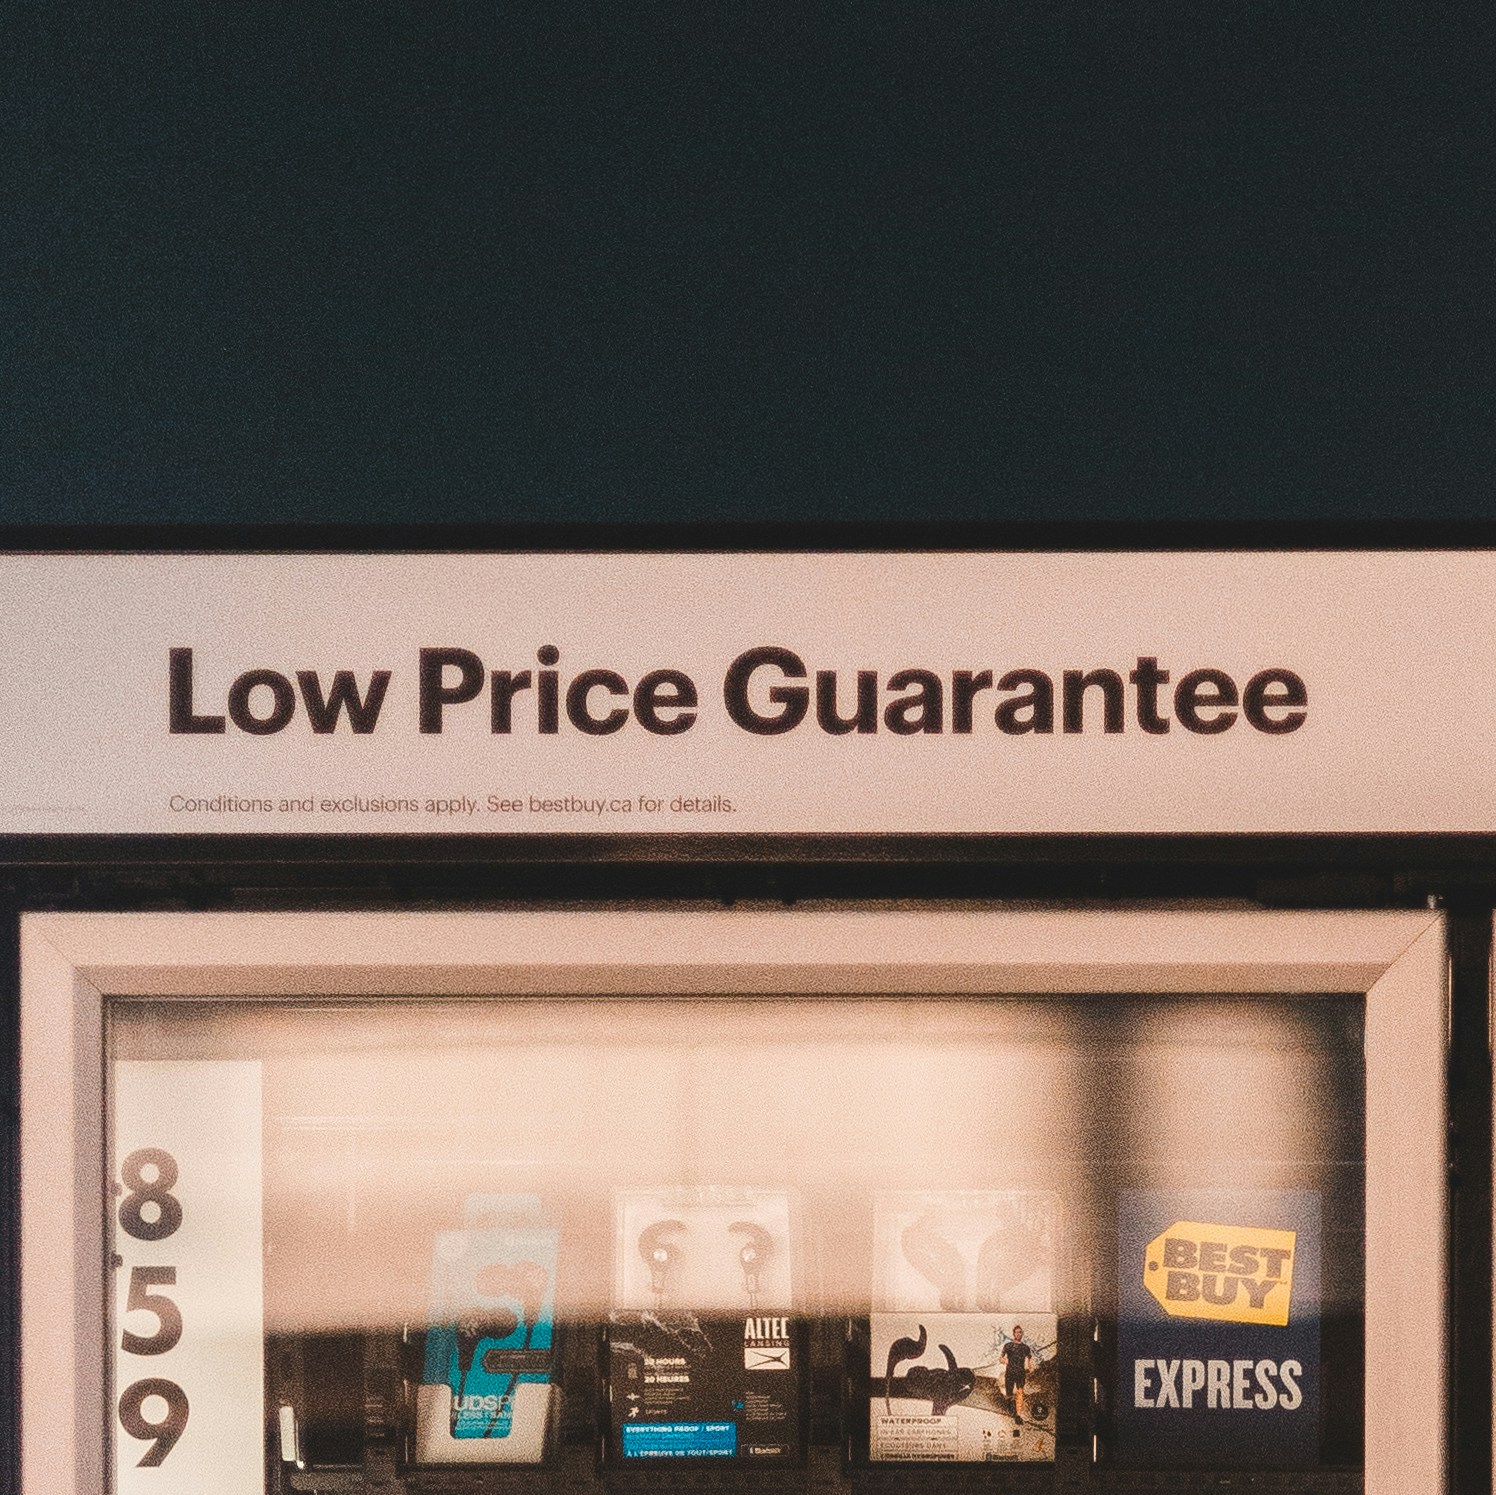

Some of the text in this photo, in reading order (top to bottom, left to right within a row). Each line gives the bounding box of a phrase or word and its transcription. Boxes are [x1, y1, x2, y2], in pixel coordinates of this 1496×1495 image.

[169, 644, 1308, 735] Low Price Guarantee
[170, 795, 737, 817] Conditions and exclusions apply. See bestbuy.ca for details.
[1163, 1238, 1291, 1276] BEST
[1165, 1274, 1276, 1311] BUY
[1133, 1359, 1303, 1410] EXPRESS
